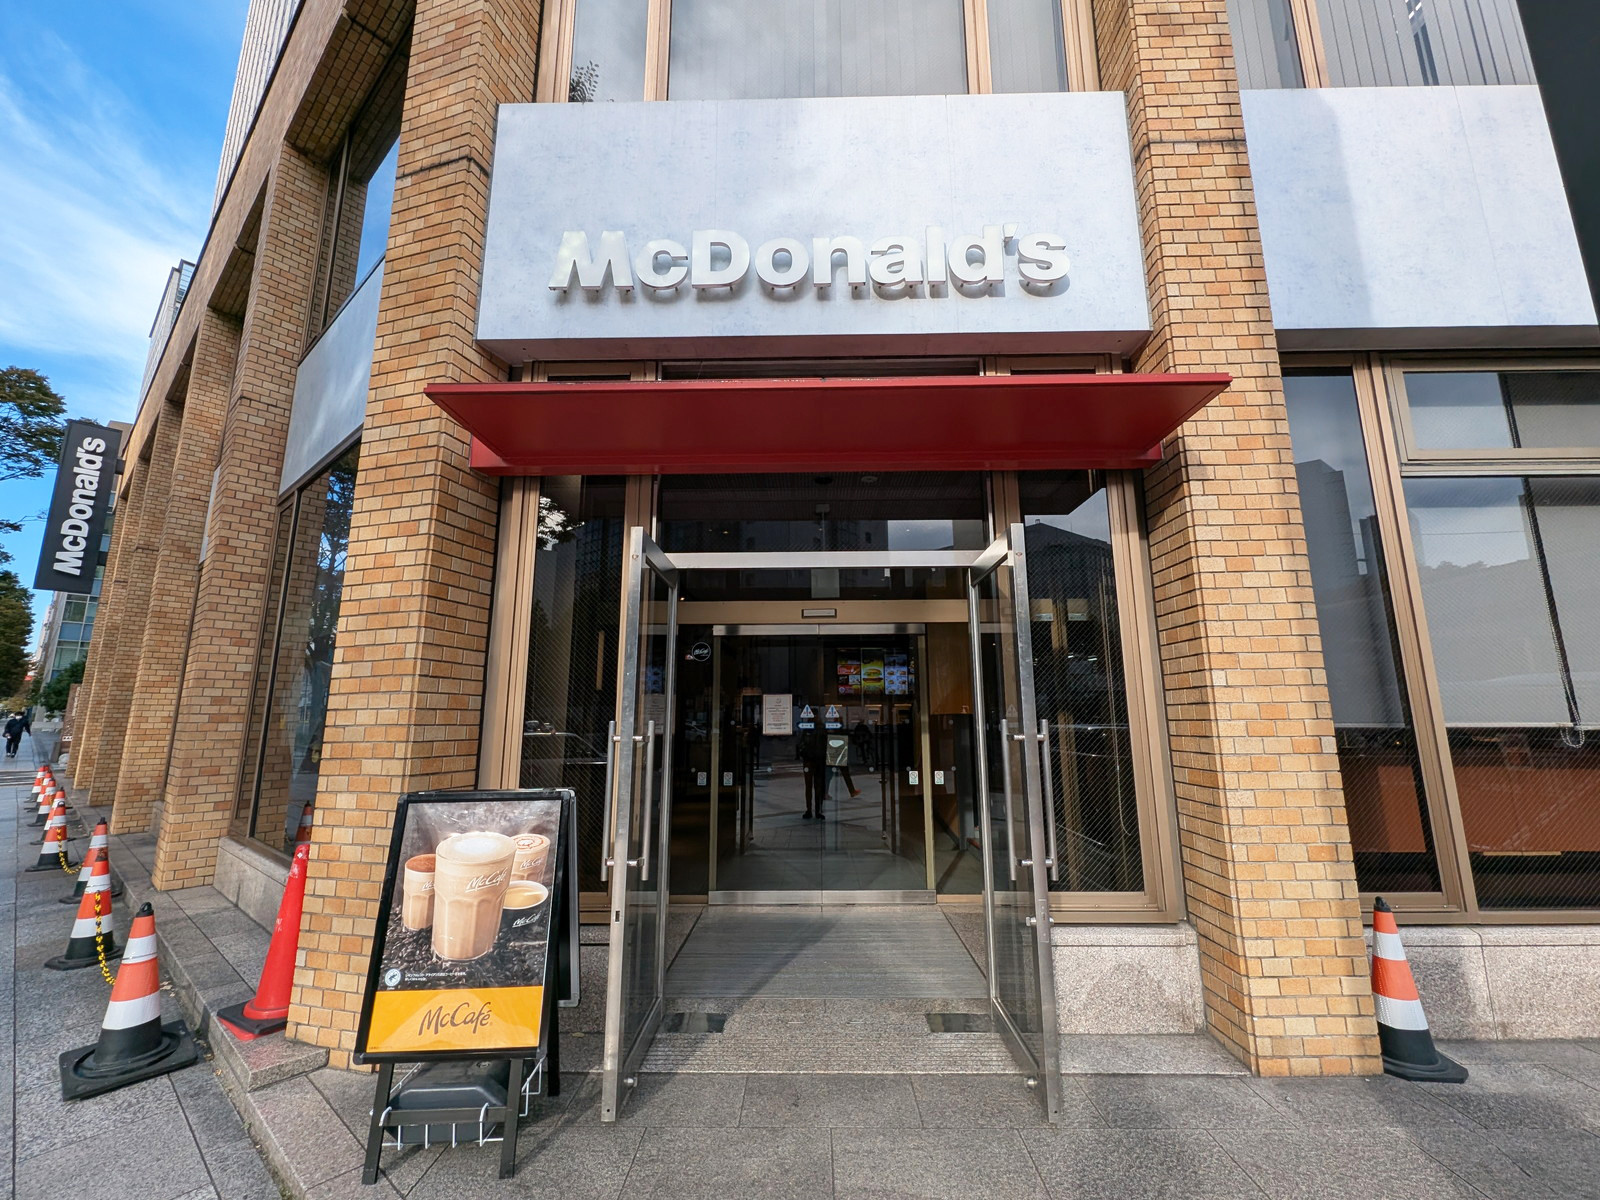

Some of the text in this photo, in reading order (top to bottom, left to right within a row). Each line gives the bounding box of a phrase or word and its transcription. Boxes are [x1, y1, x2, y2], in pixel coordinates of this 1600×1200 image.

[548, 222, 1071, 291] McDonald's
[53, 437, 106, 576] McDonald's
[418, 1002, 492, 1036] McCafé
